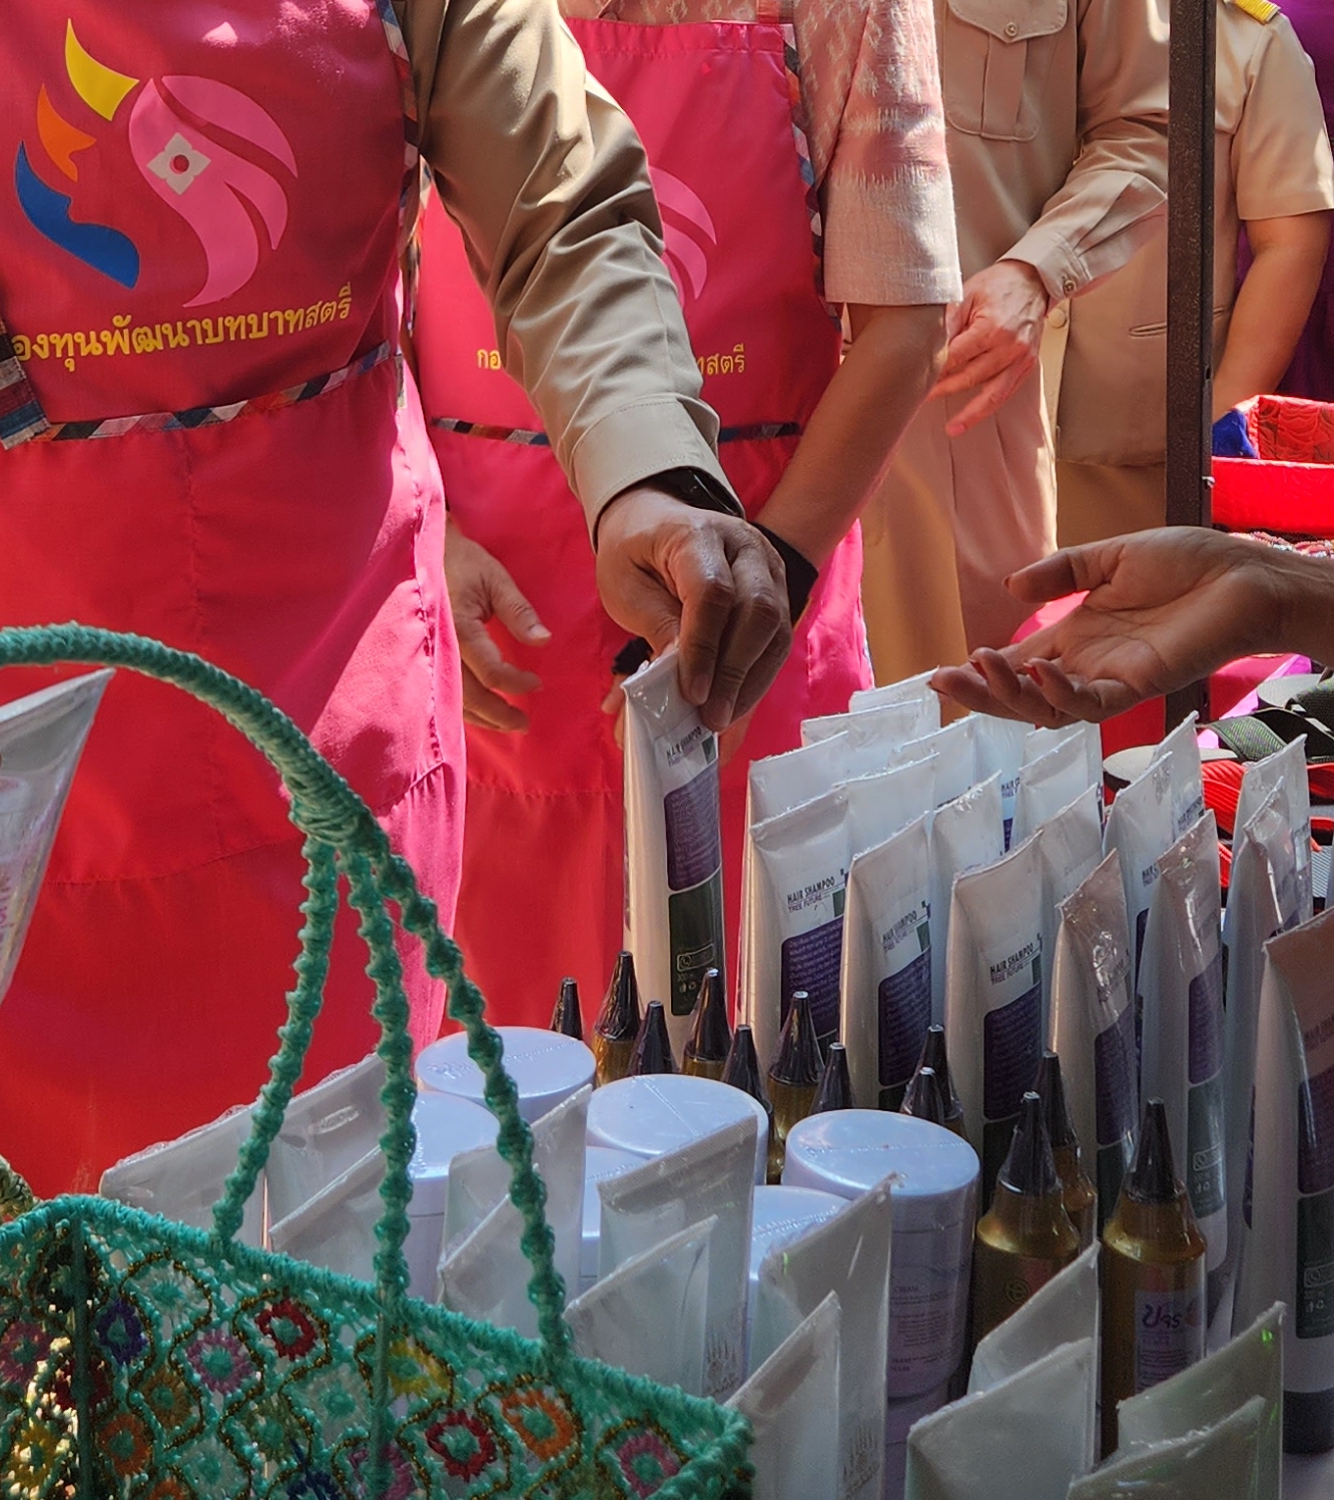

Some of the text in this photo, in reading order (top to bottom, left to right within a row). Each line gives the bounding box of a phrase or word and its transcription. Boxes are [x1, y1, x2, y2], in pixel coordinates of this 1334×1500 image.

[11, 282, 352, 372] องทุนพัฒนาบทบาทสตรี
[787, 876, 835, 904] HAIR SHAMPOO
[990, 942, 1034, 976] HAIR SHAMPOO
